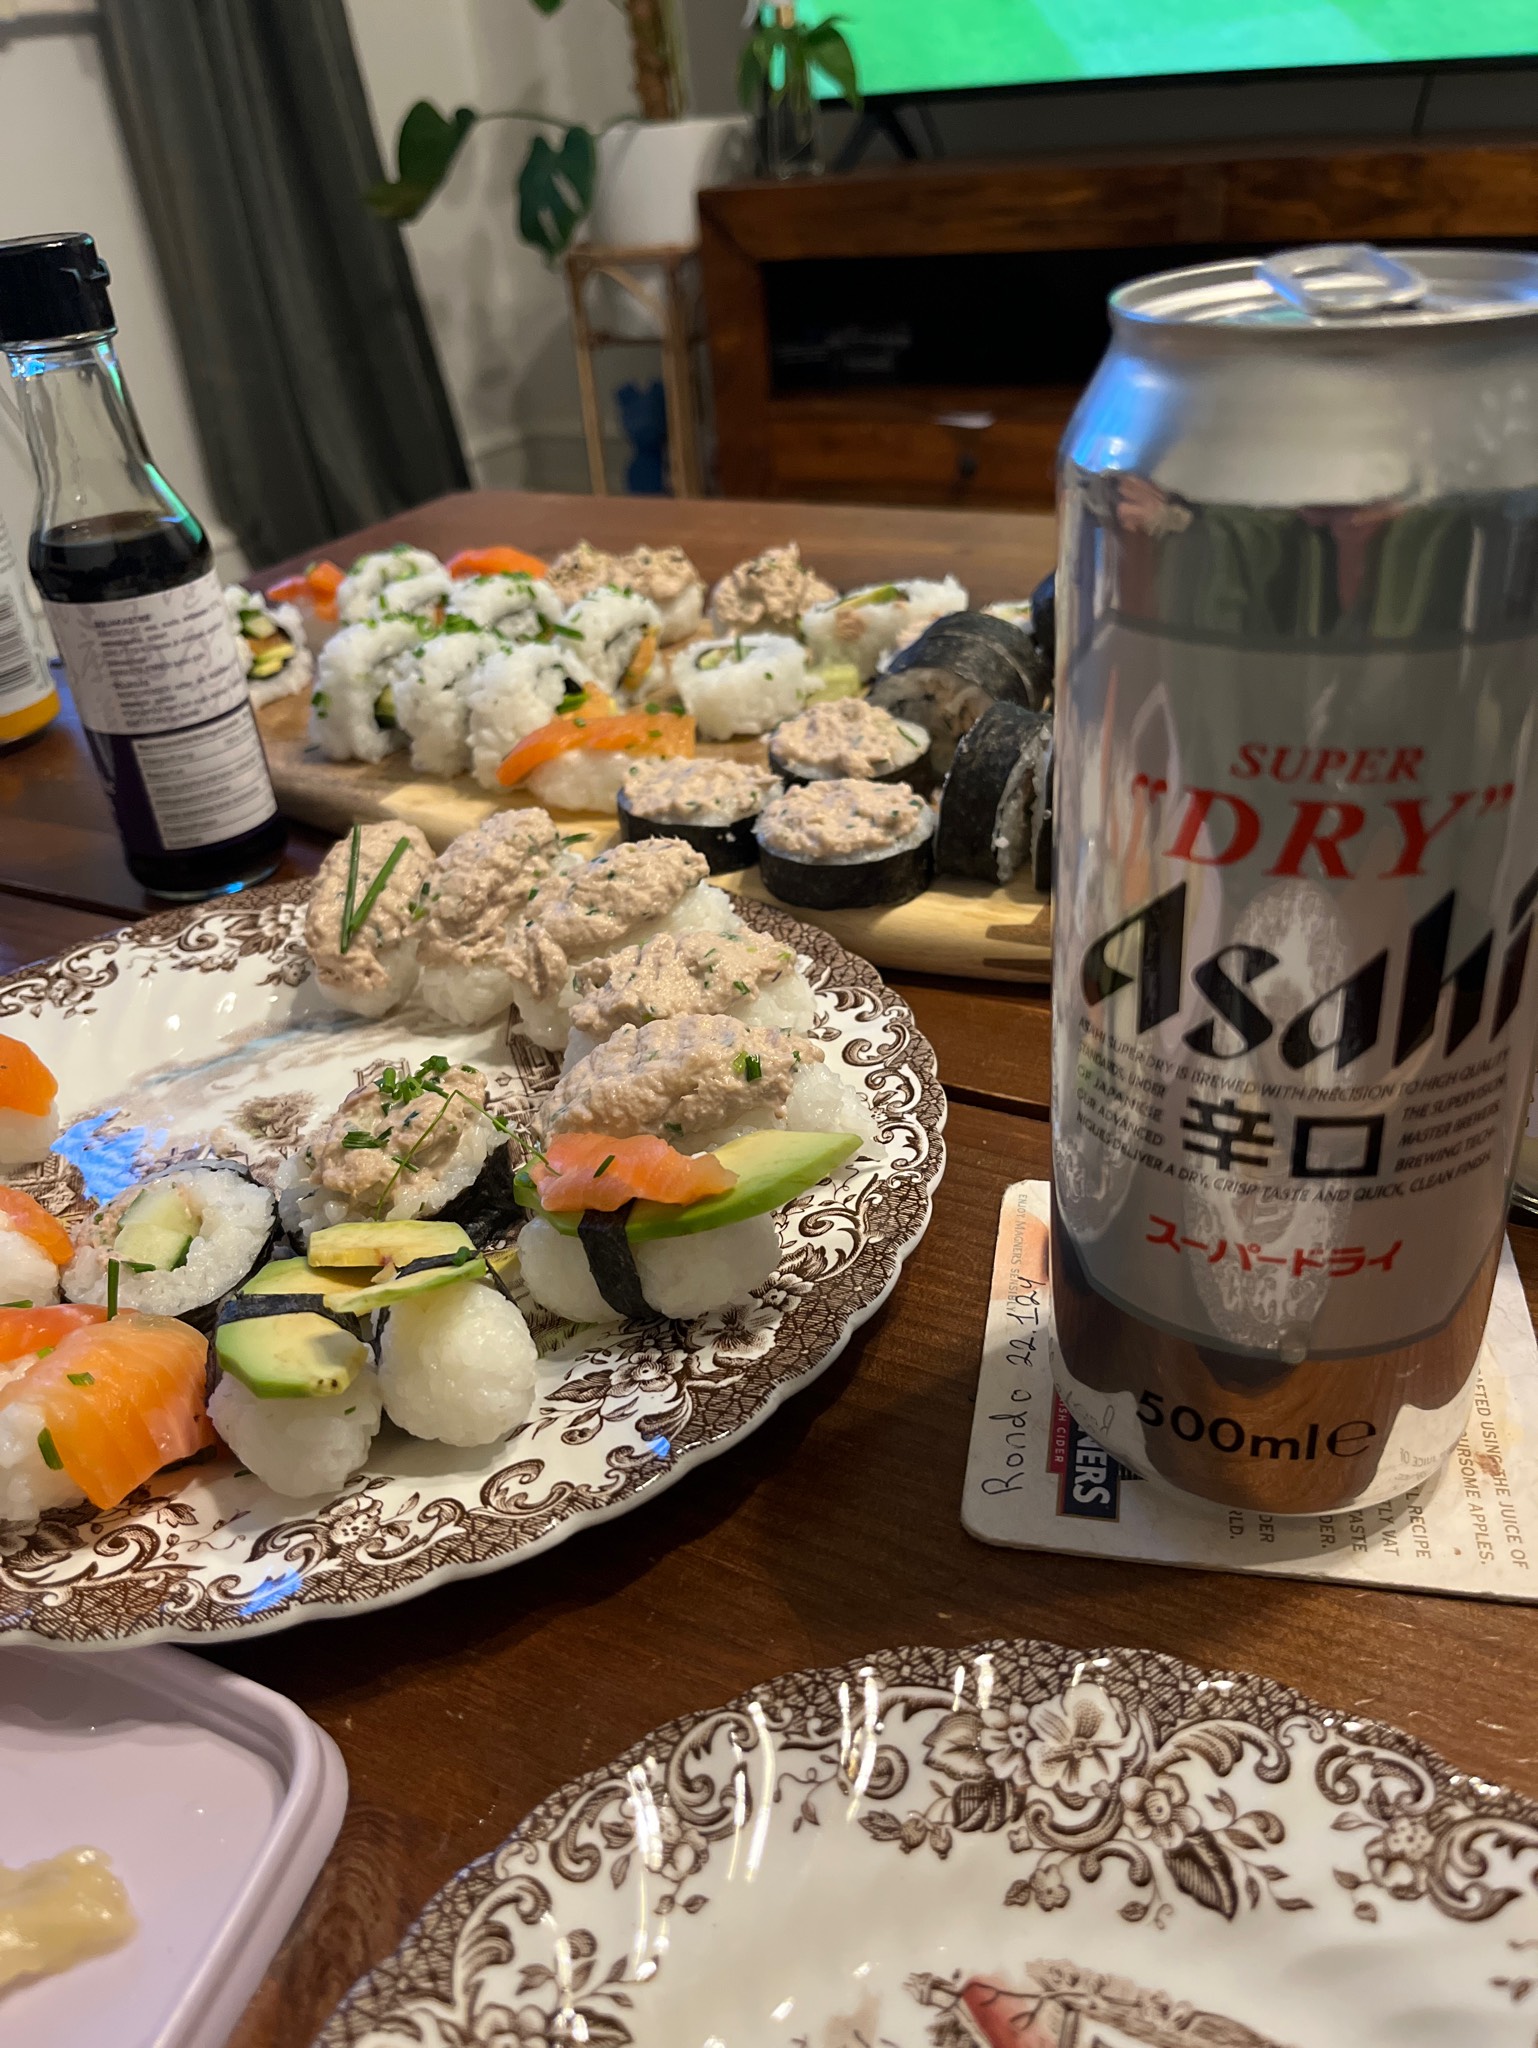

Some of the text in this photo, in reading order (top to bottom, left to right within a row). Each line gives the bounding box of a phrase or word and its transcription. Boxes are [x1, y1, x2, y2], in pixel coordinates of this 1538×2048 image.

[1230, 741, 1426, 784] SUPER
[1080, 866, 1538, 1073] Asahi
[1108, 1035, 1144, 1062] SUPER
[1145, 1054, 1174, 1073] DRY
[1176, 1066, 1188, 1080] IS
[1190, 1071, 1257, 1094] BREWED
[1261, 1083, 1305, 1100] WITH
[1306, 1083, 1395, 1102] PRECISION
[1398, 1080, 1420, 1096] TO
[1420, 1071, 1459, 1094] HIGH
[1127, 1071, 1166, 1099] UNDER
[1401, 1103, 1430, 1121] THE
[1097, 1105, 1164, 1147] ADVANCED
[1394, 1141, 1463, 1173] BREWING
[1180, 1098, 1386, 1179] 辛口
[1398, 1121, 1454, 1147] MASTER
[1111, 1137, 1163, 1171] DELIVER
[1164, 1164, 1175, 1176] A
[1177, 1168, 1209, 1188] DRY,
[1213, 1177, 1257, 1196] CRISP
[1261, 1184, 1309, 1202] TASTE
[1311, 1187, 1351, 1202] AND
[1409, 1168, 1455, 1193] CLEAN
[1006, 1193, 1028, 1313] ENJOY MAGNERS SENSIBLY
[1145, 1214, 1403, 1277] スーパードライ
[981, 1389, 1032, 1495] Rondo
[1054, 1427, 1067, 1463] CIDER
[1348, 1510, 1368, 1553] TASTE
[1382, 1529, 1400, 1557] VAT
[1407, 1505, 1432, 1560] RECIPE
[1467, 1502, 1495, 1565] APPLES.
[1498, 1501, 1524, 1544] JUICE
[1510, 1548, 1530, 1570] OF
